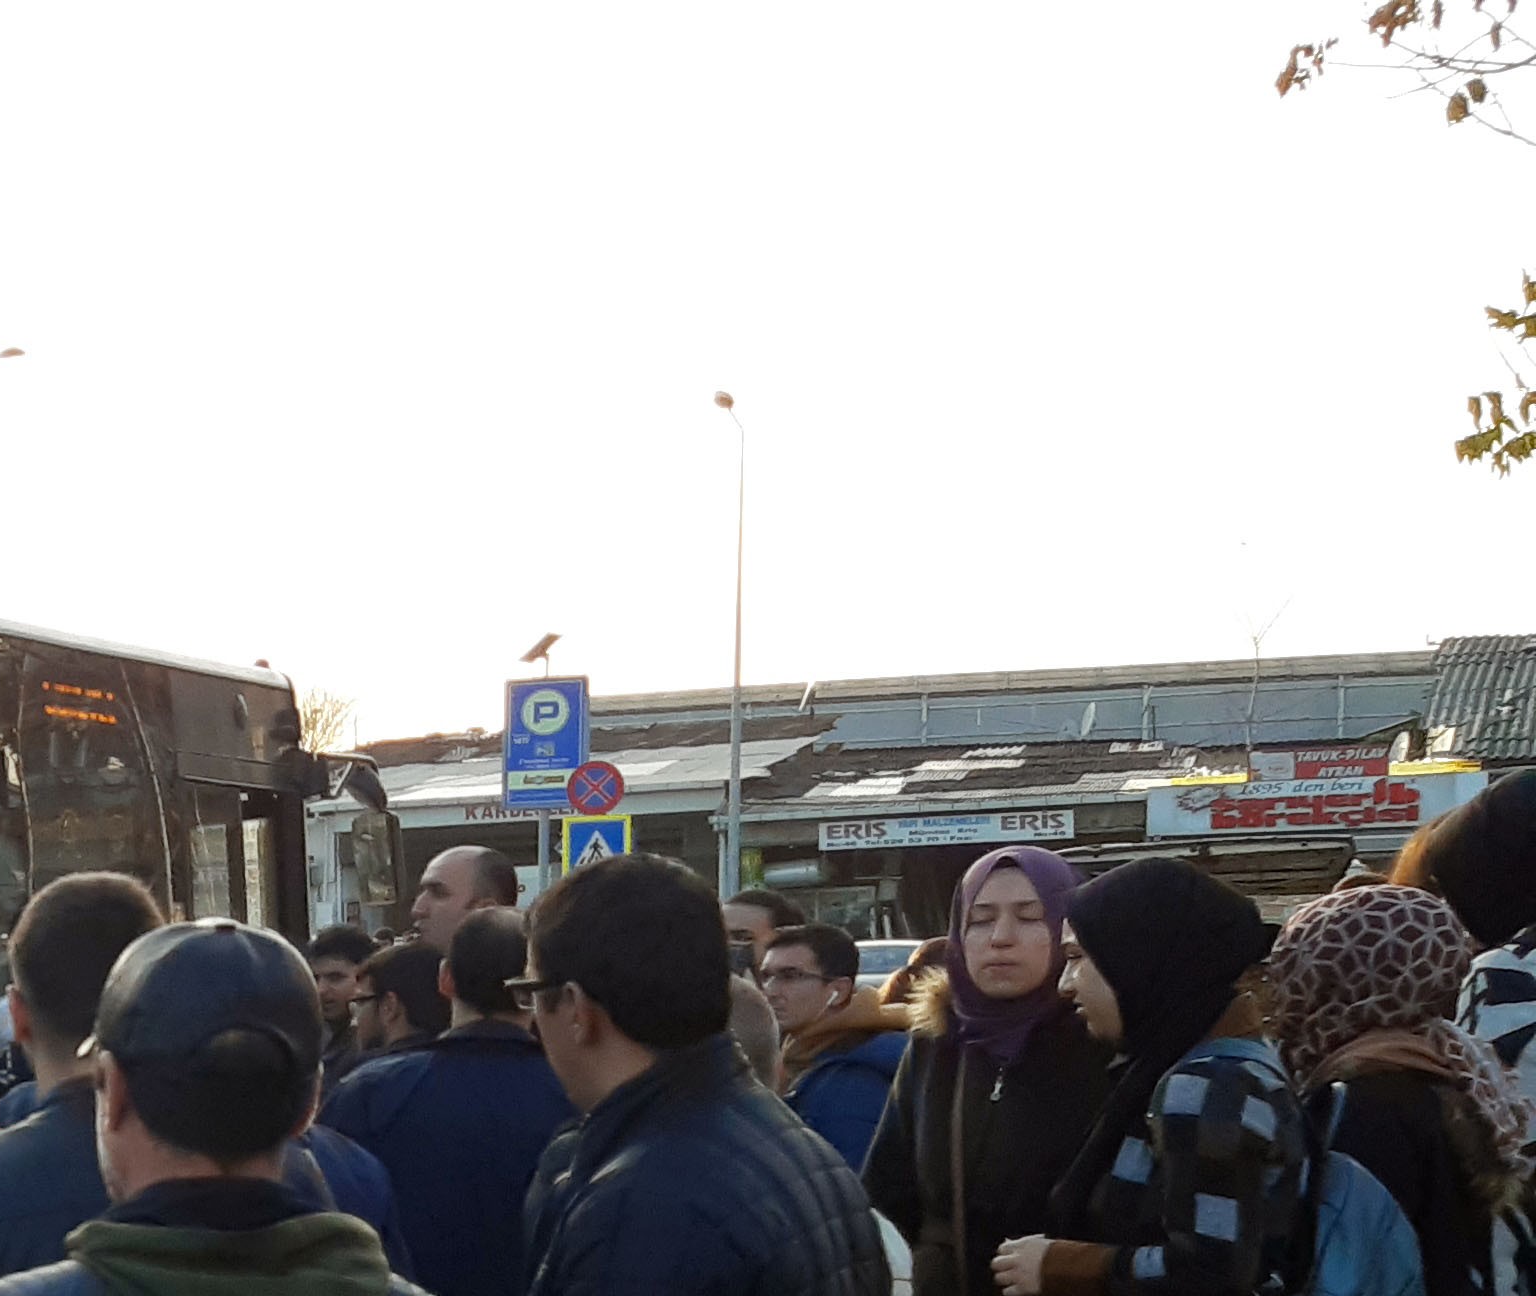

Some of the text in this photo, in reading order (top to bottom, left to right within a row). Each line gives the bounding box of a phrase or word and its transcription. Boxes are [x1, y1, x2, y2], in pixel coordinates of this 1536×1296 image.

[533, 702, 560, 723] P
[1317, 765, 1364, 778] AYRAN
[1239, 779, 1364, 795] 1895 den beri
